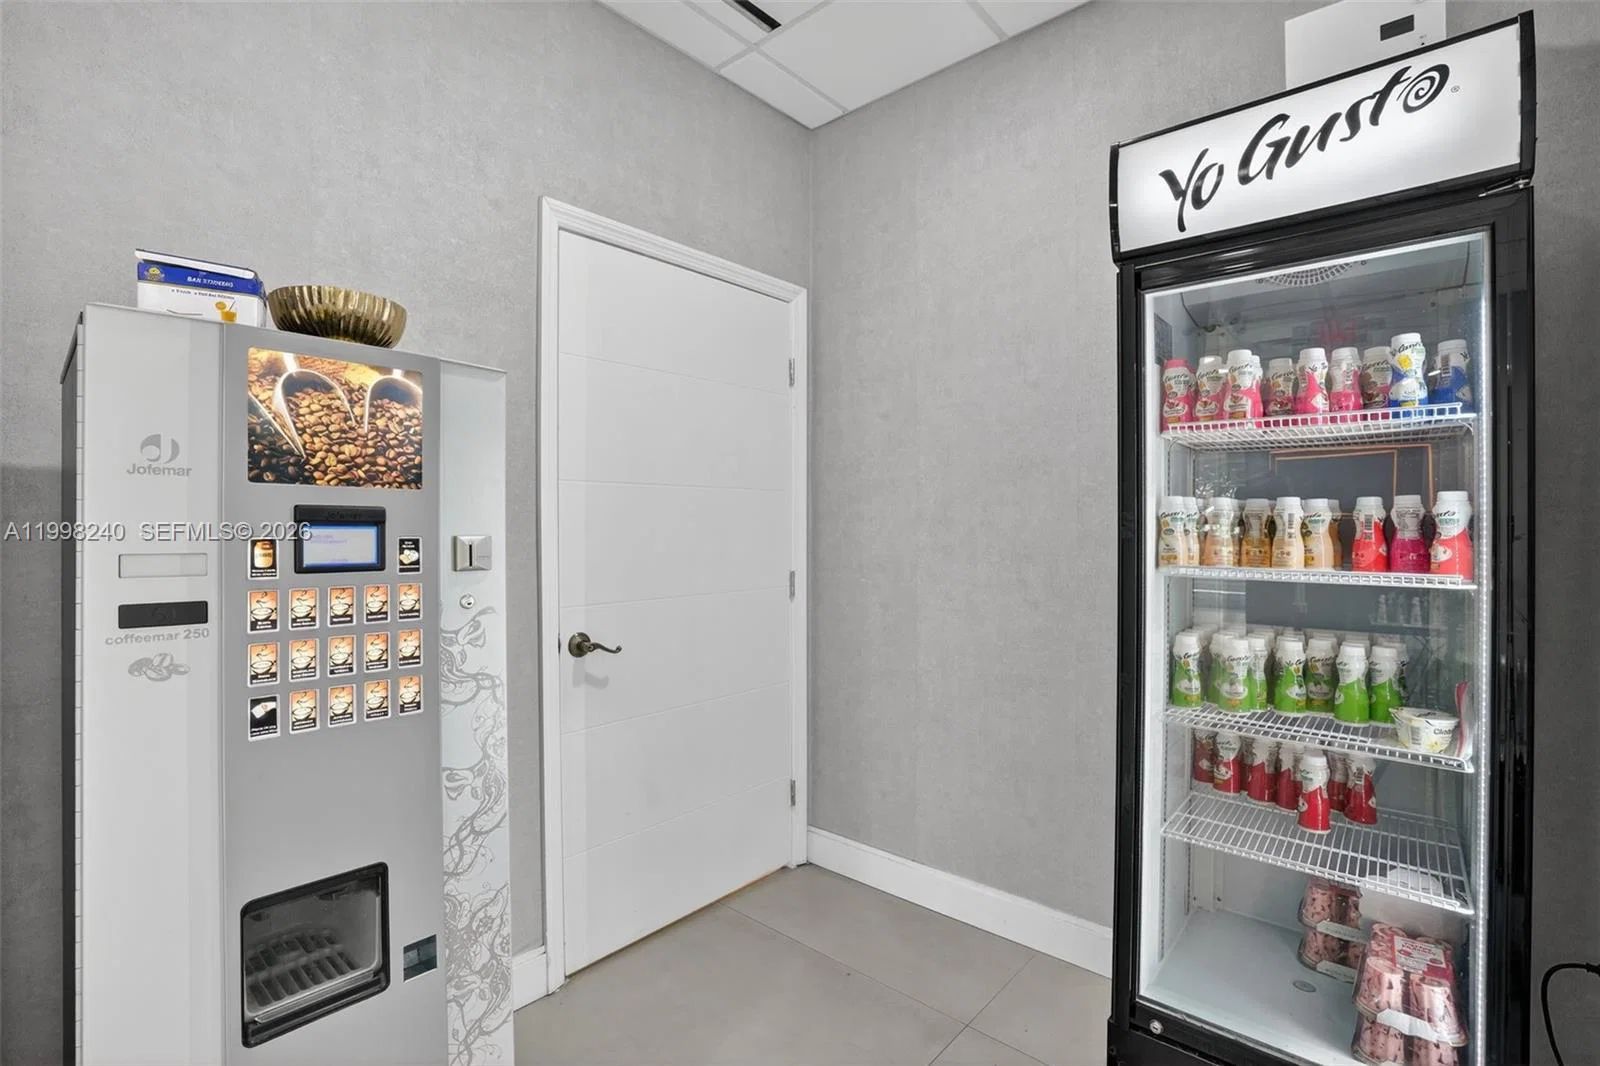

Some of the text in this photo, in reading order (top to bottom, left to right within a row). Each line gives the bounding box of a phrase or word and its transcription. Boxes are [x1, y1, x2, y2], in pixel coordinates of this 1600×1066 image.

[1158, 63, 1450, 233] Yo Gusto
[126, 463, 192, 478] Jofemar
[105, 629, 210, 646] coffeemar 250
